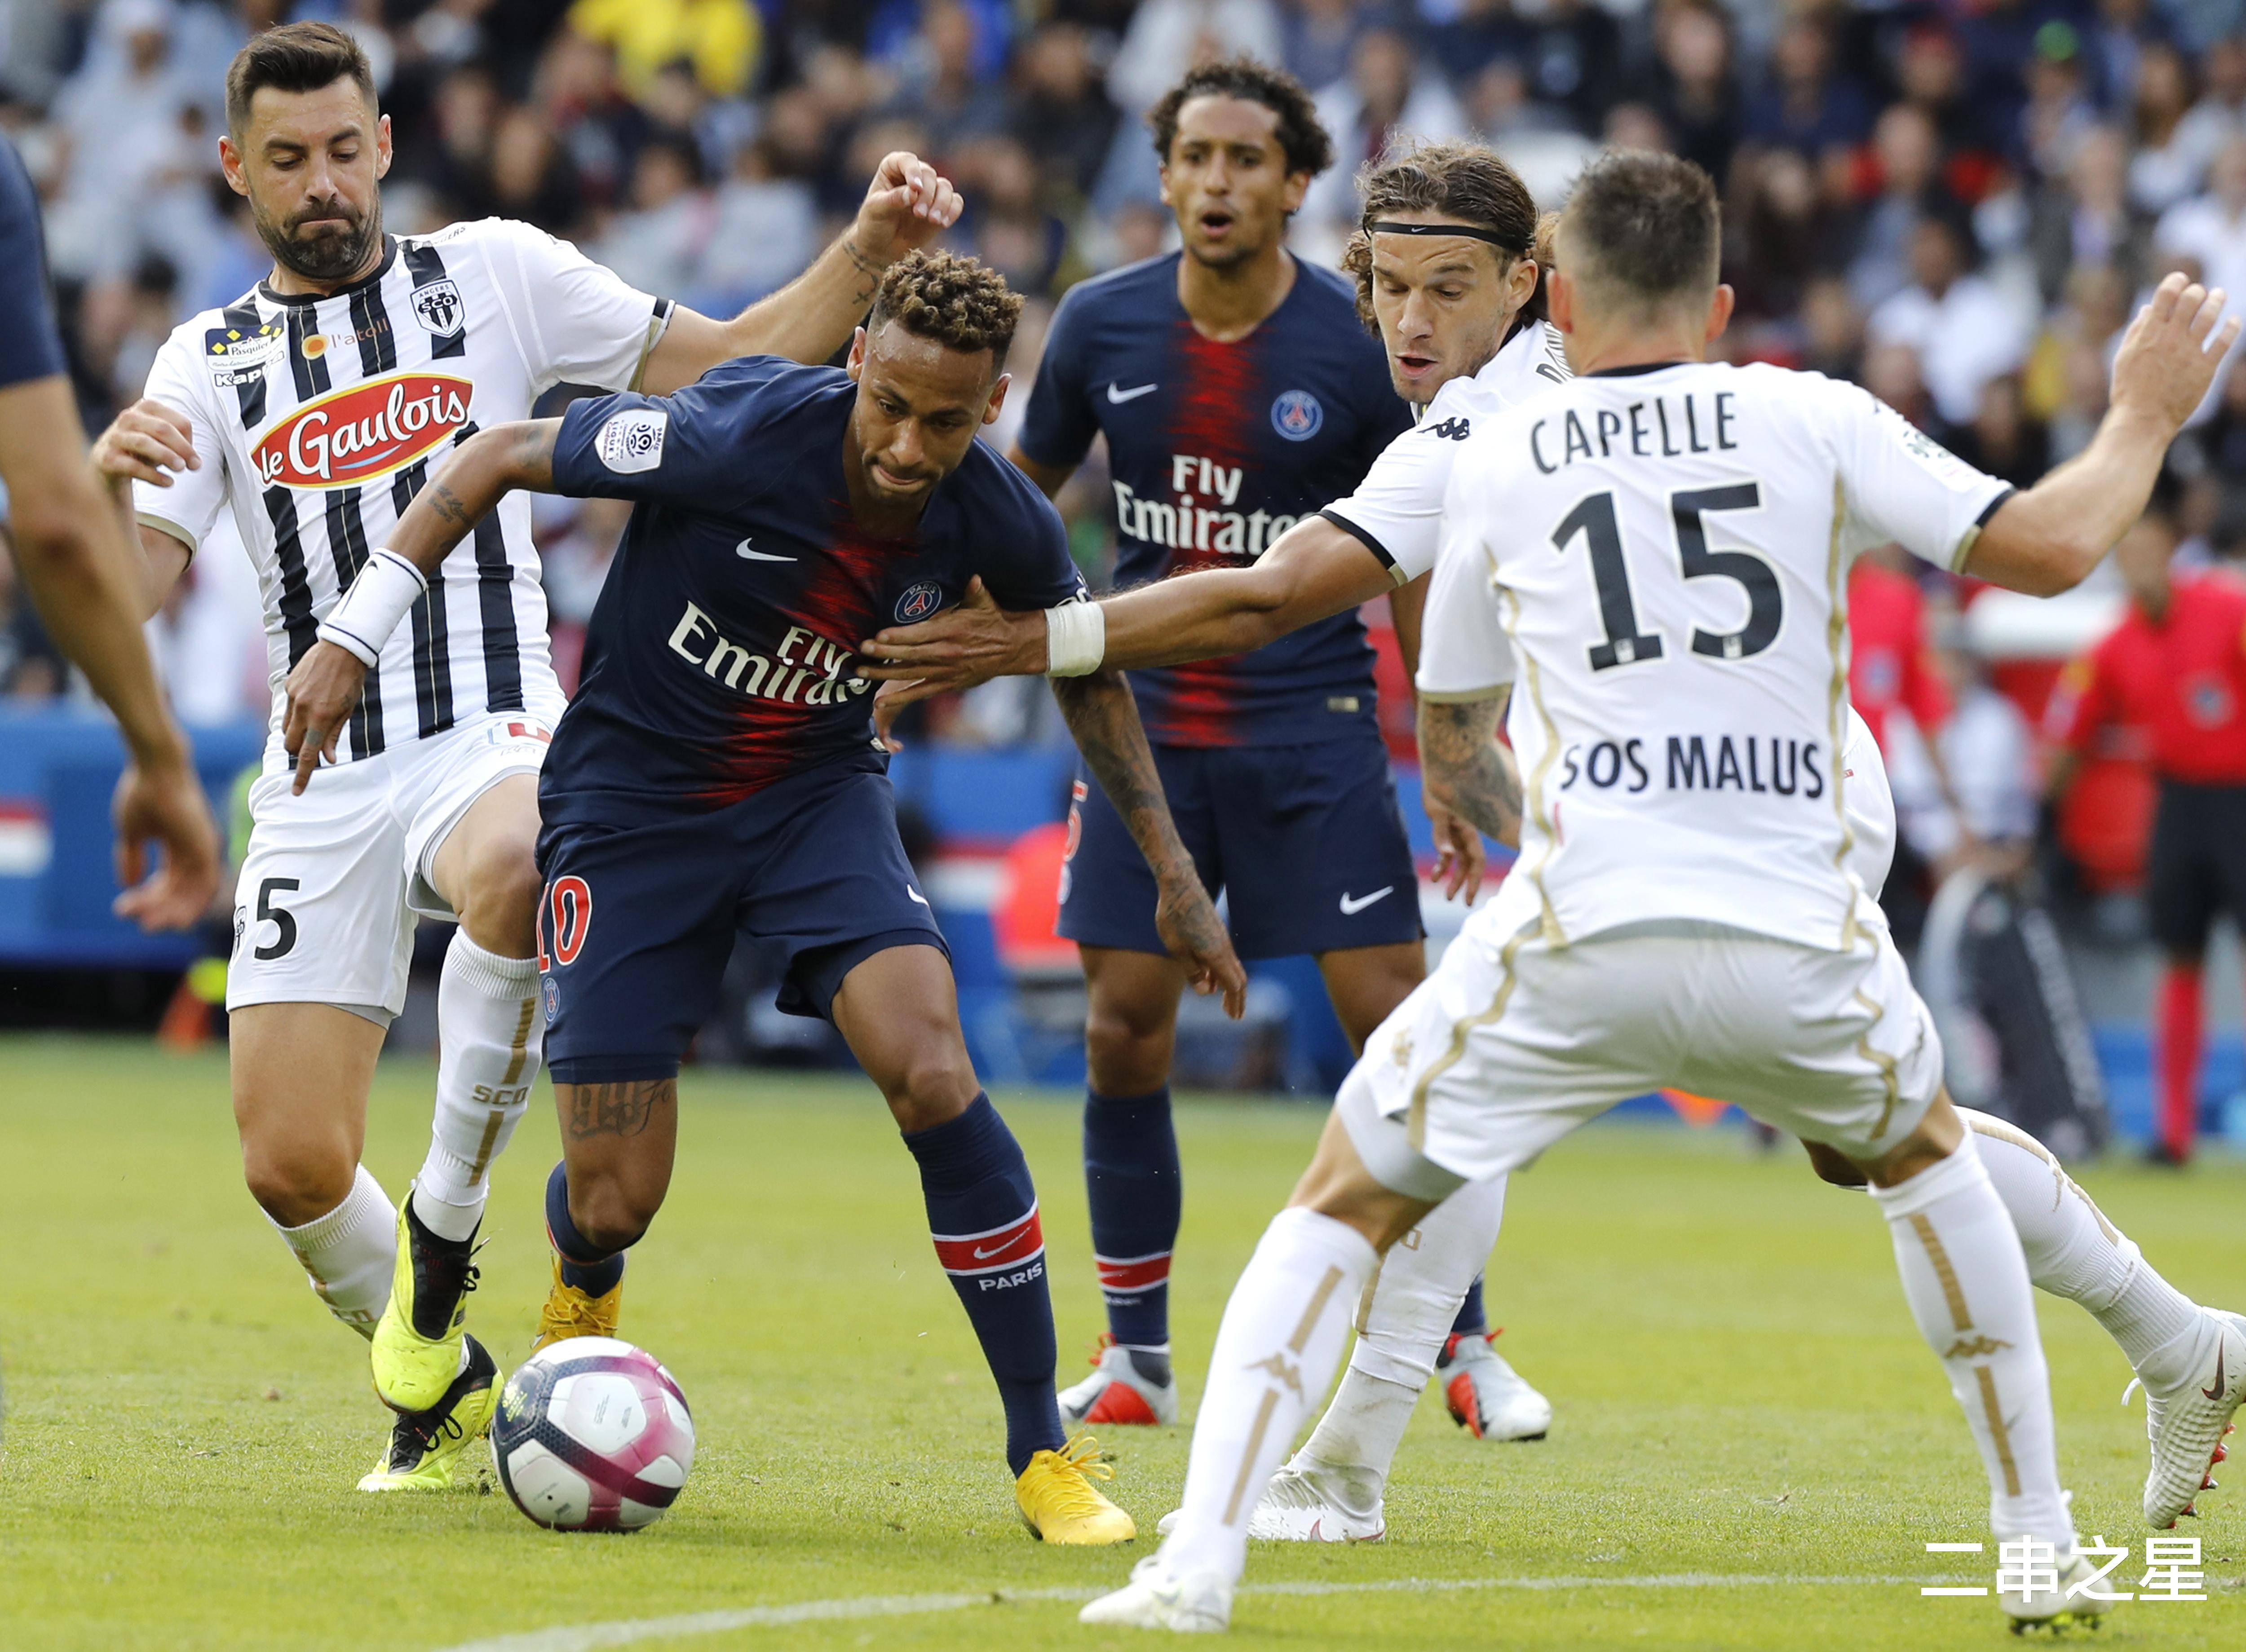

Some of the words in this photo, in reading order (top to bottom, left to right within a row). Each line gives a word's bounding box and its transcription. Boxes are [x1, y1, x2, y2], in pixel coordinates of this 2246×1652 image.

[419, 284, 450, 298] ANGERS
[421, 296, 453, 312] SCO
[231, 341, 269, 356] Pasquier
[331, 318, 389, 349] l'atoll
[214, 350, 285, 387] Kap
[261, 446, 284, 481] le
[288, 383, 466, 480] Gaulois
[1531, 392, 1737, 474] CAPELLE
[1172, 454, 1243, 506] Fly
[1112, 479, 1315, 556] Emirate
[909, 584, 937, 595] PARIS
[1551, 482, 1782, 671] 15
[776, 626, 853, 681] Fly
[1561, 739, 1649, 793] SOS
[1668, 737, 1823, 799] MALUS
[254, 878, 300, 960] 5
[473, 1083, 529, 1105] SCO
[978, 1262, 1043, 1291] PARIS
